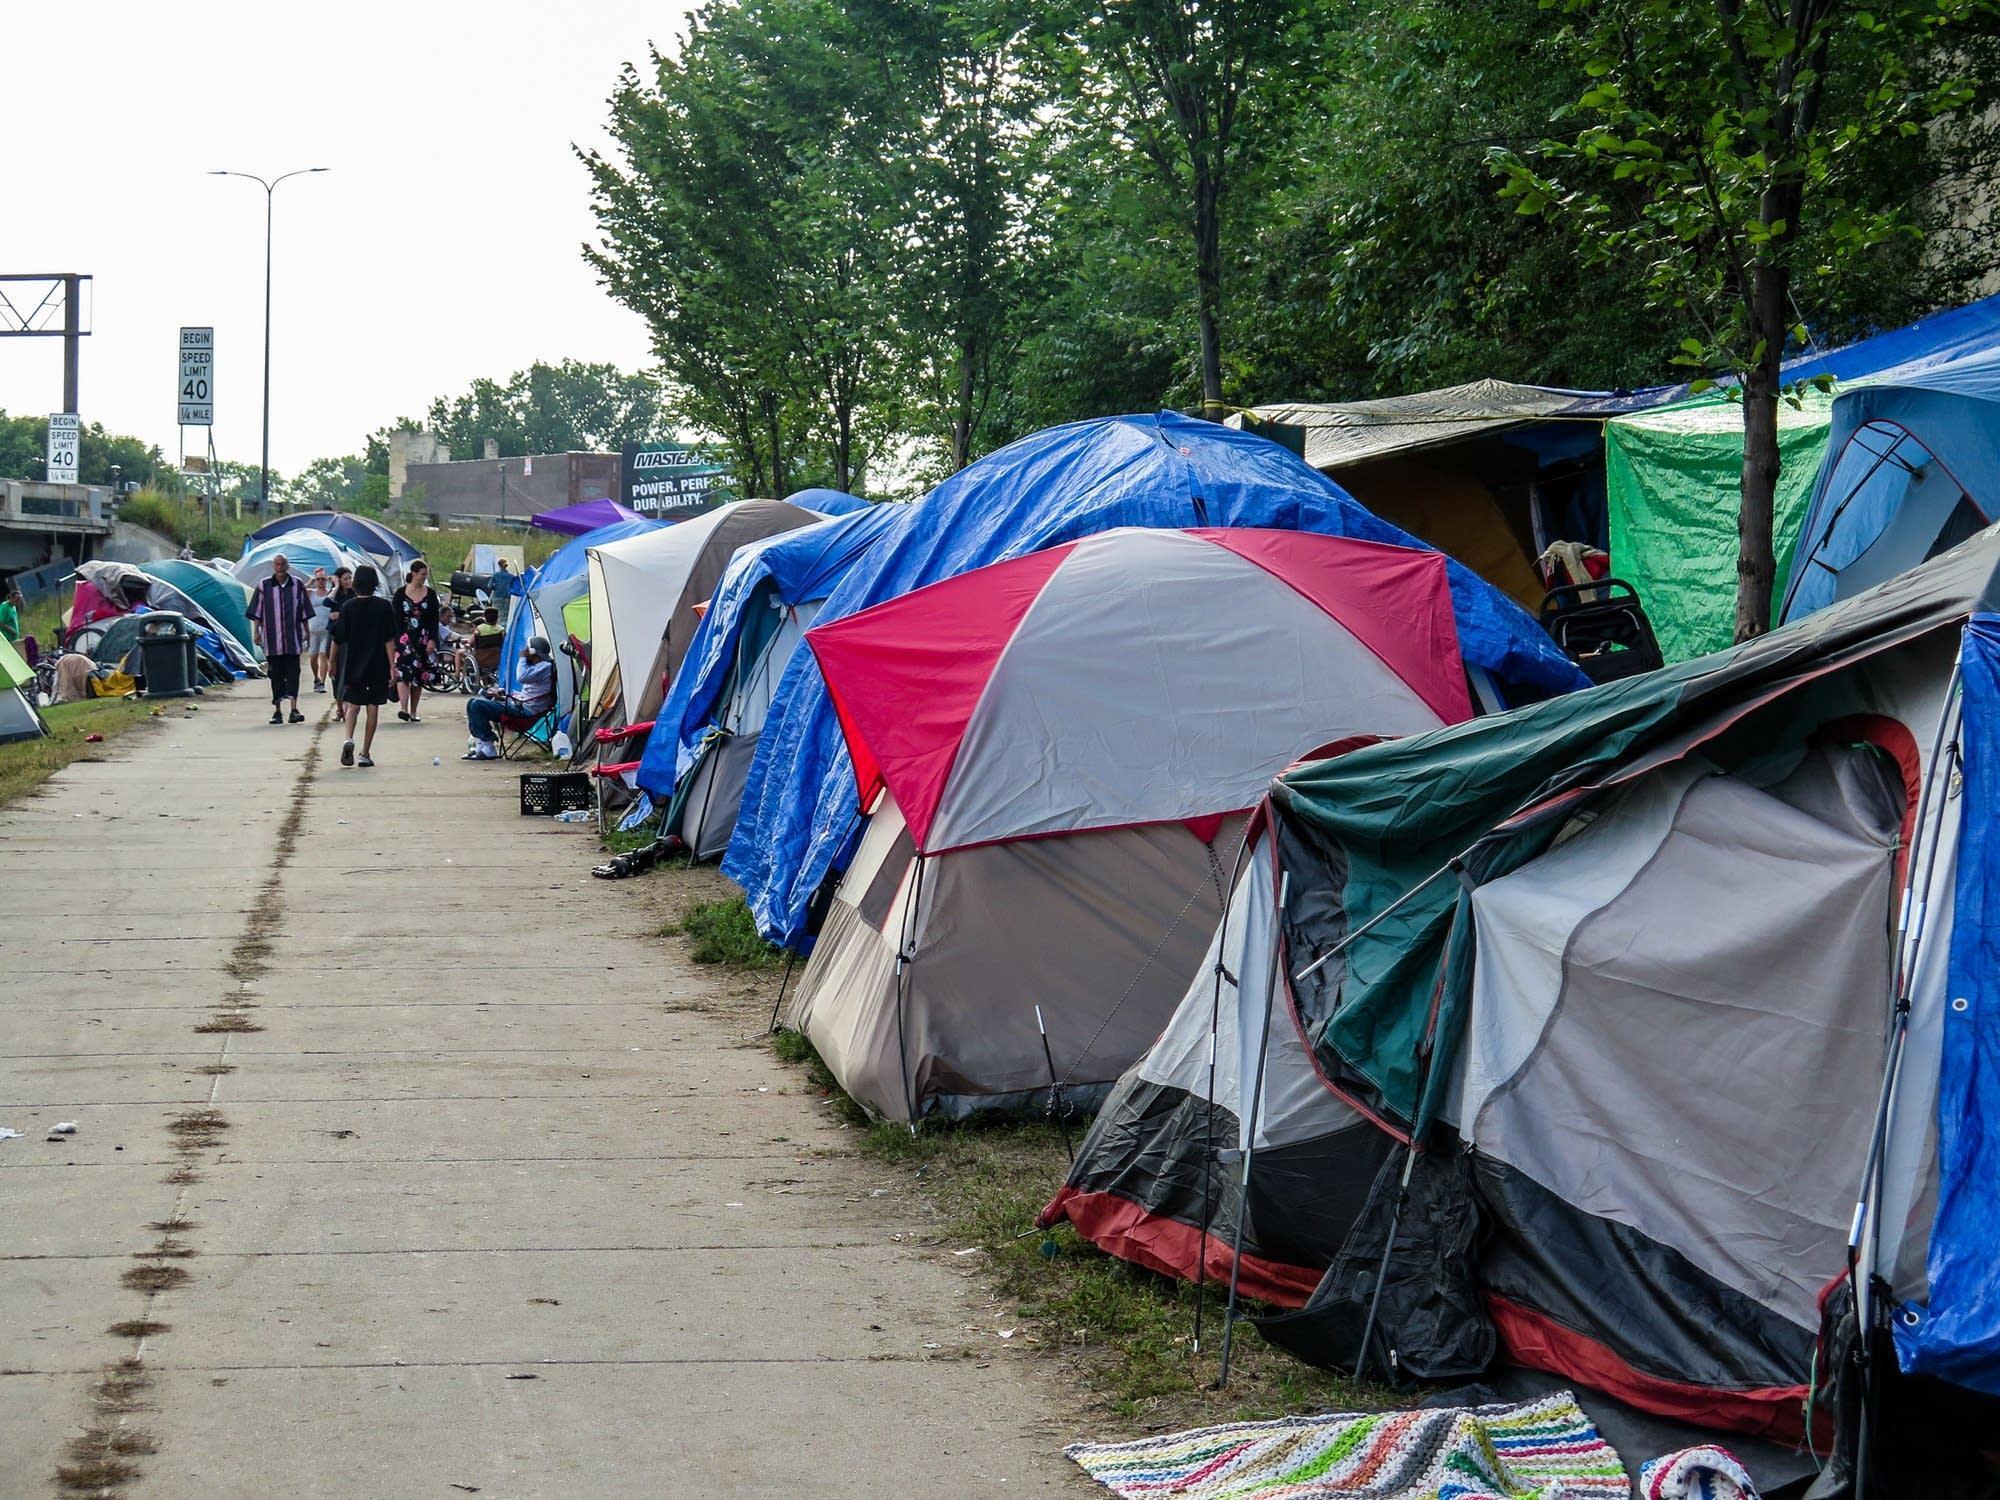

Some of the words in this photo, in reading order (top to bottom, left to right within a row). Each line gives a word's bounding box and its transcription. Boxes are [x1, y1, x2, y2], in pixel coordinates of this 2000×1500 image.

[183, 333, 210, 344] BEGIN
[182, 352, 211, 363] SPEED
[184, 366, 207, 377] LIMIT
[183, 379, 208, 400] 40
[193, 409, 210, 419] MILE
[53, 417, 77, 426] BEGIN
[51, 431, 77, 440] SPEED
[53, 441, 73, 450] LIMIT
[53, 451, 74, 466] 40
[61, 472, 75, 481] MILE
[632, 481, 678, 497] POWER.
